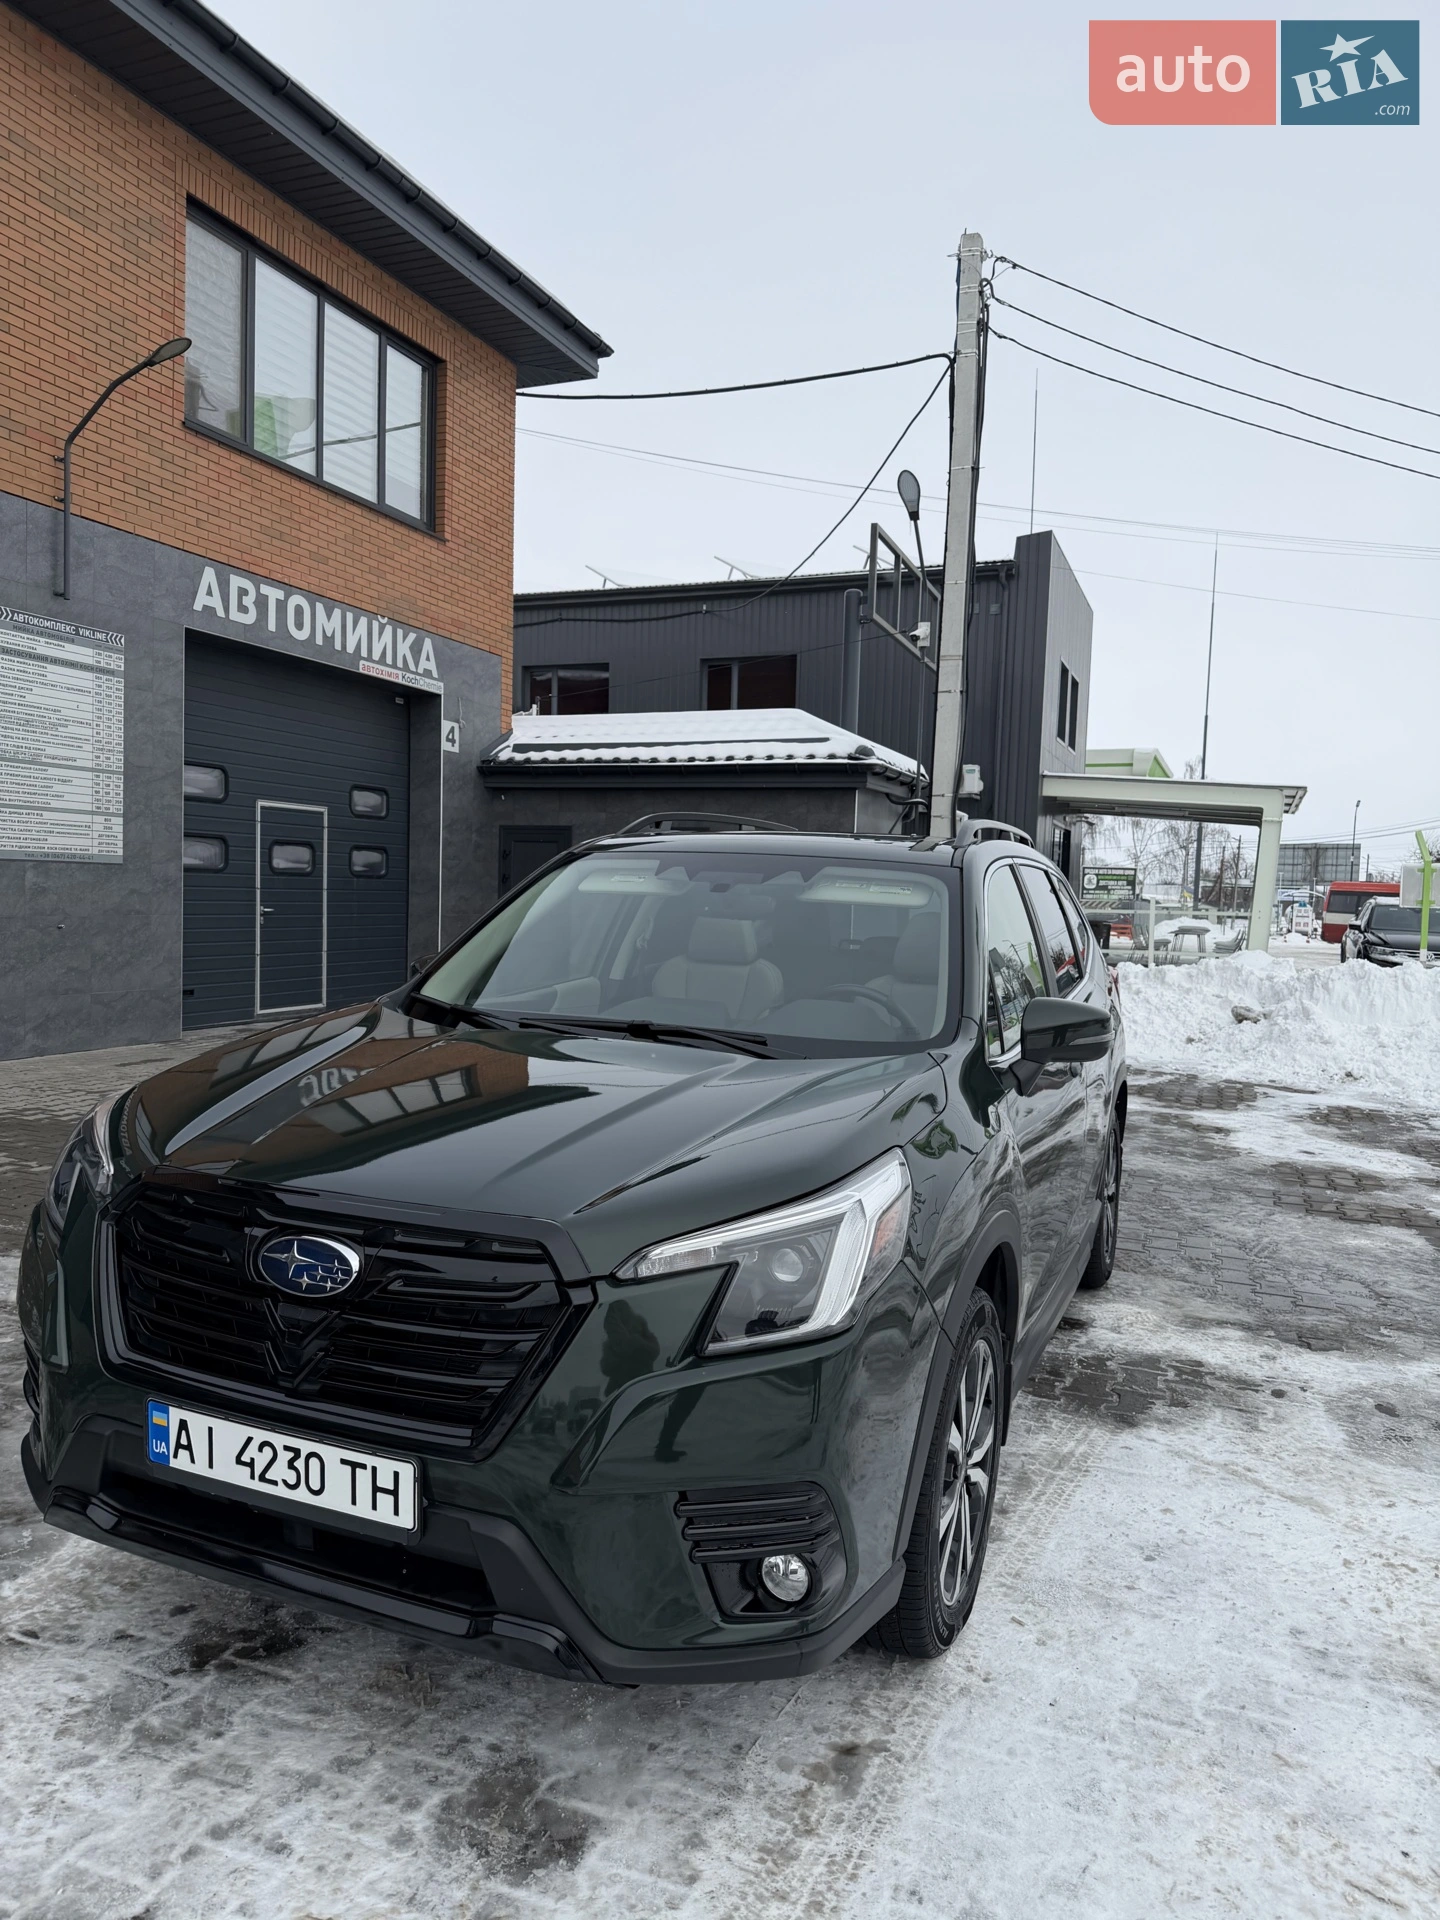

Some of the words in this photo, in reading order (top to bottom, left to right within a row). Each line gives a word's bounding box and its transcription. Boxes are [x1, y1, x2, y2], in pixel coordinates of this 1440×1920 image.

[13, 612, 75, 634] АВТОКОМПЛЕКС
[79, 627, 107, 641] VIKLINE
[193, 566, 438, 678] АВТОМИЙКА
[13, 625, 34, 635] МИЙКА
[36, 630, 75, 643] АВТОМОБІЛІВ
[1, 648, 48, 662] ЗАСТОСУВАННЯ
[402, 672, 442, 692] KochChemie
[446, 725, 456, 748] 4
[152, 1438, 168, 1456] UA
[172, 1418, 214, 1470] AI
[235, 1436, 326, 1497] 4230
[340, 1457, 400, 1517] TH
